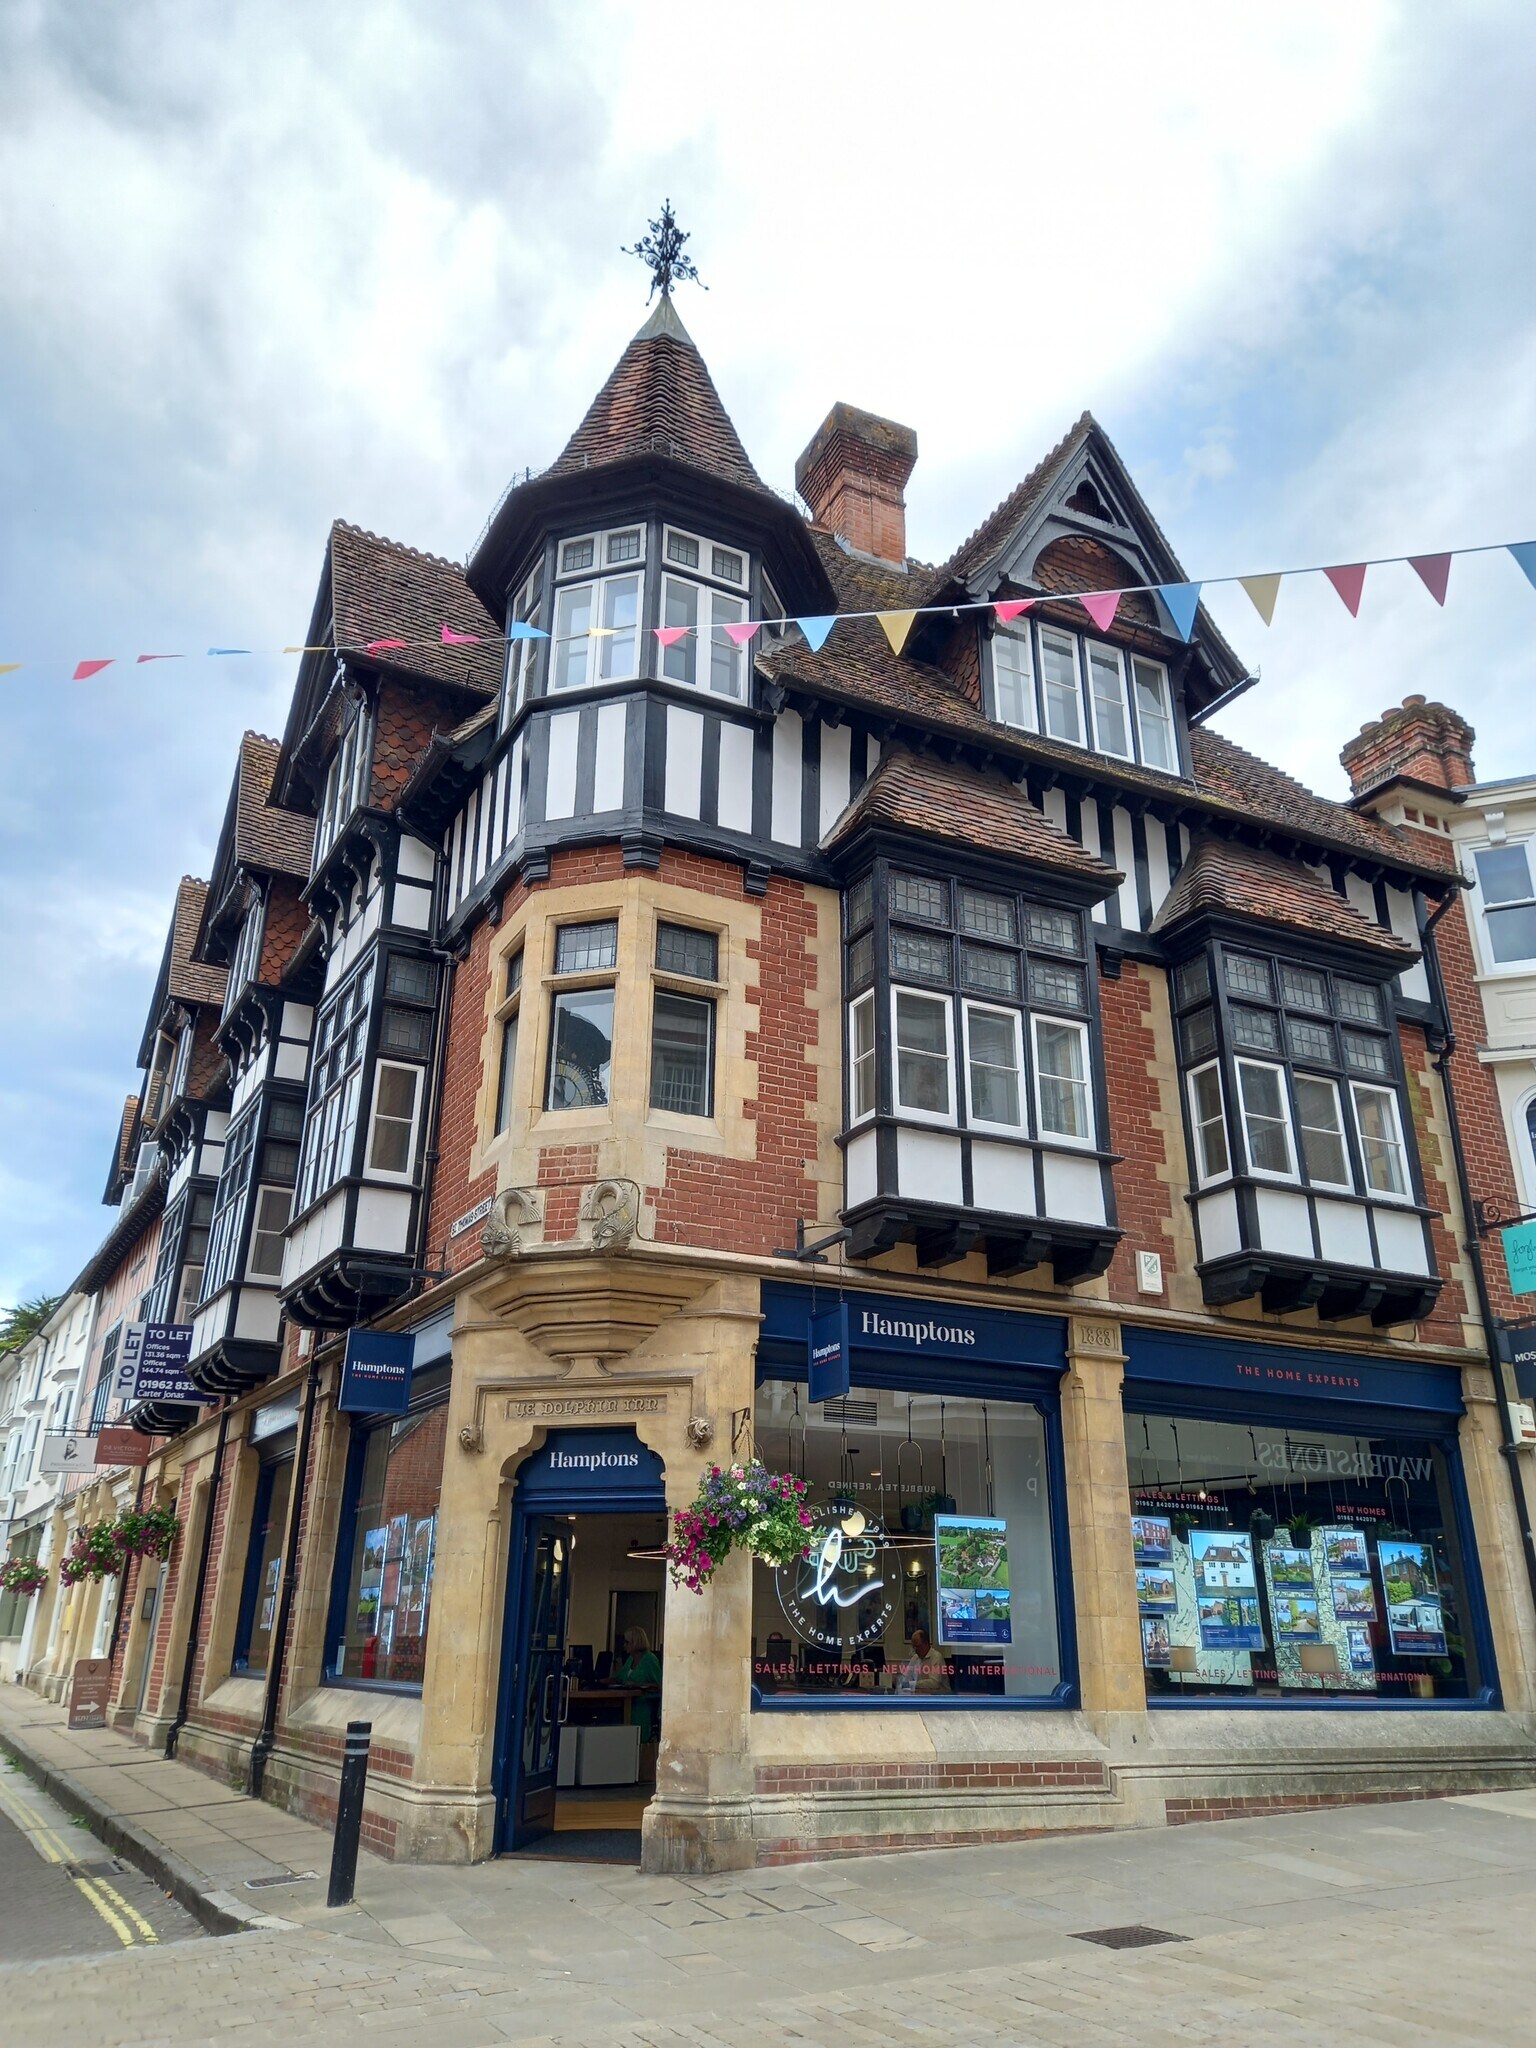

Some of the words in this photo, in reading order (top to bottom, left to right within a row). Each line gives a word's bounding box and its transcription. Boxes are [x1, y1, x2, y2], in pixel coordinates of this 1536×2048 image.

[474, 1198, 491, 1220] STREET
[148, 1329, 166, 1340] TO
[168, 1330, 192, 1341] LET
[861, 1311, 976, 1346] Hamptons
[122, 1329, 142, 1360] LET
[146, 1343, 170, 1351] Offices
[812, 1342, 841, 1360] Hamptons
[143, 1359, 167, 1367] Offices
[352, 1360, 405, 1374] Hamptons
[117, 1365, 135, 1389] TO
[1236, 1364, 1261, 1377] THE
[1267, 1369, 1301, 1381] HOME
[1308, 1373, 1360, 1388] EXPERTS
[139, 1380, 173, 1390] 01962
[136, 1389, 162, 1398] Carter
[549, 1451, 639, 1472] Hamptons
[1134, 1489, 1163, 1499] SALES
[1166, 1492, 1172, 1500] &
[1175, 1492, 1220, 1504] LETTINGS
[1335, 1505, 1355, 1513] NEW
[1357, 1506, 1386, 1516] HOMES
[788, 1600, 806, 1626] THE
[808, 1626, 843, 1646] HOME
[849, 1603, 892, 1645] EXPERTS
[755, 1662, 795, 1675] SALES
[808, 1663, 870, 1675] LETTINGS
[882, 1664, 909, 1676] NEW
[914, 1664, 955, 1676] HOMES
[967, 1665, 1058, 1676] INTERNATIONAL
[1195, 1668, 1226, 1678] SALES
[1236, 1669, 1284, 1679] LETTINGS
